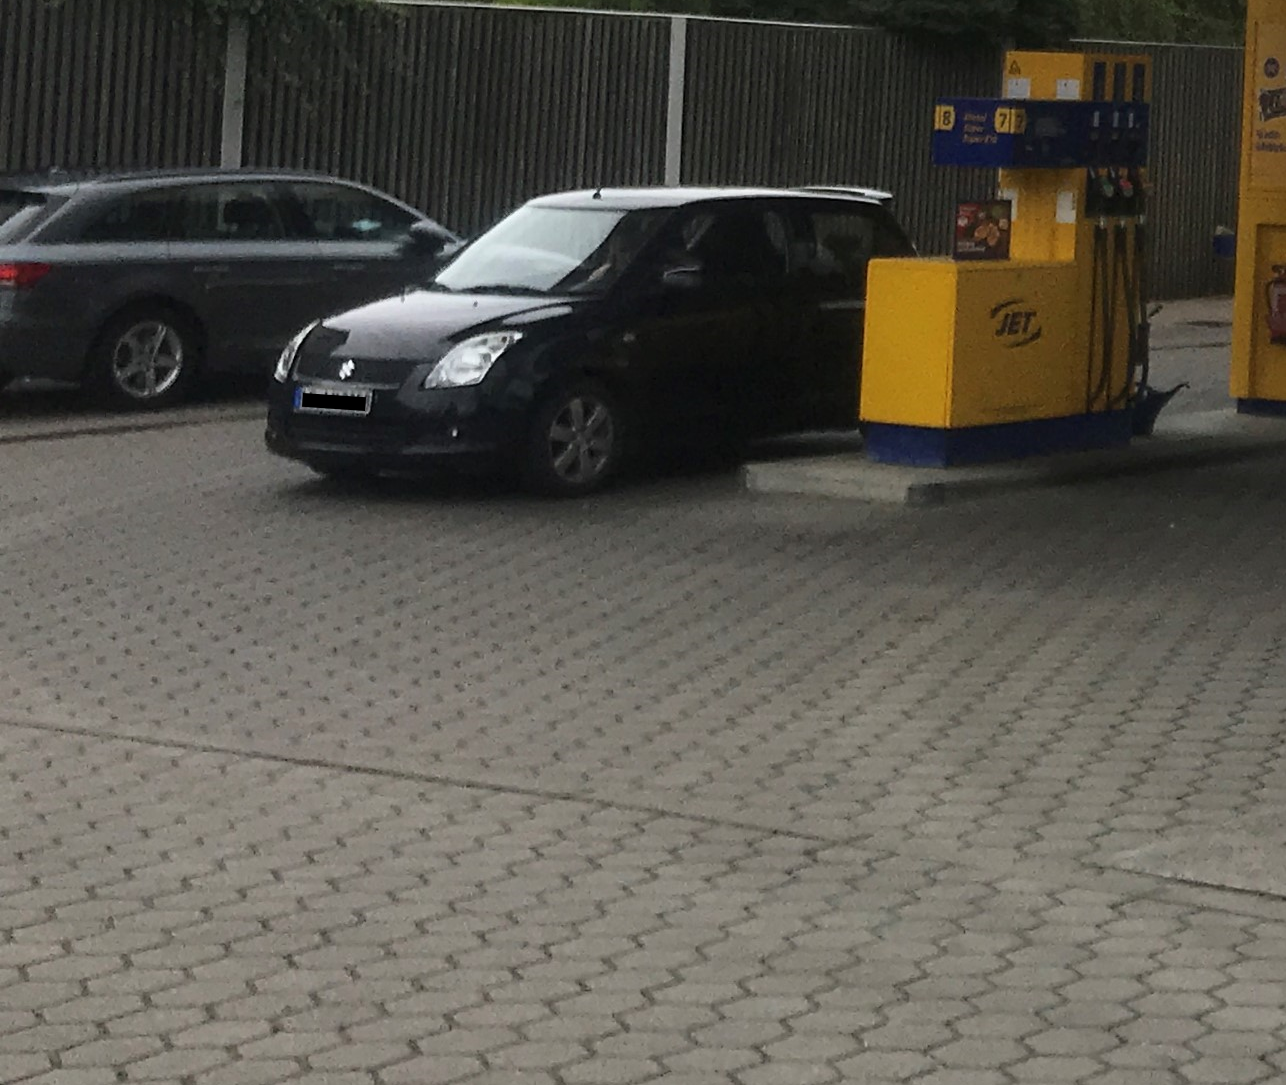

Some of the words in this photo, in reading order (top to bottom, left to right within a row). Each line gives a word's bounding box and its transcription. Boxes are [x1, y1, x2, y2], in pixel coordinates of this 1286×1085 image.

[943, 111, 951, 126] 8
[1000, 113, 1007, 128] 7
[995, 311, 1037, 337] JET
